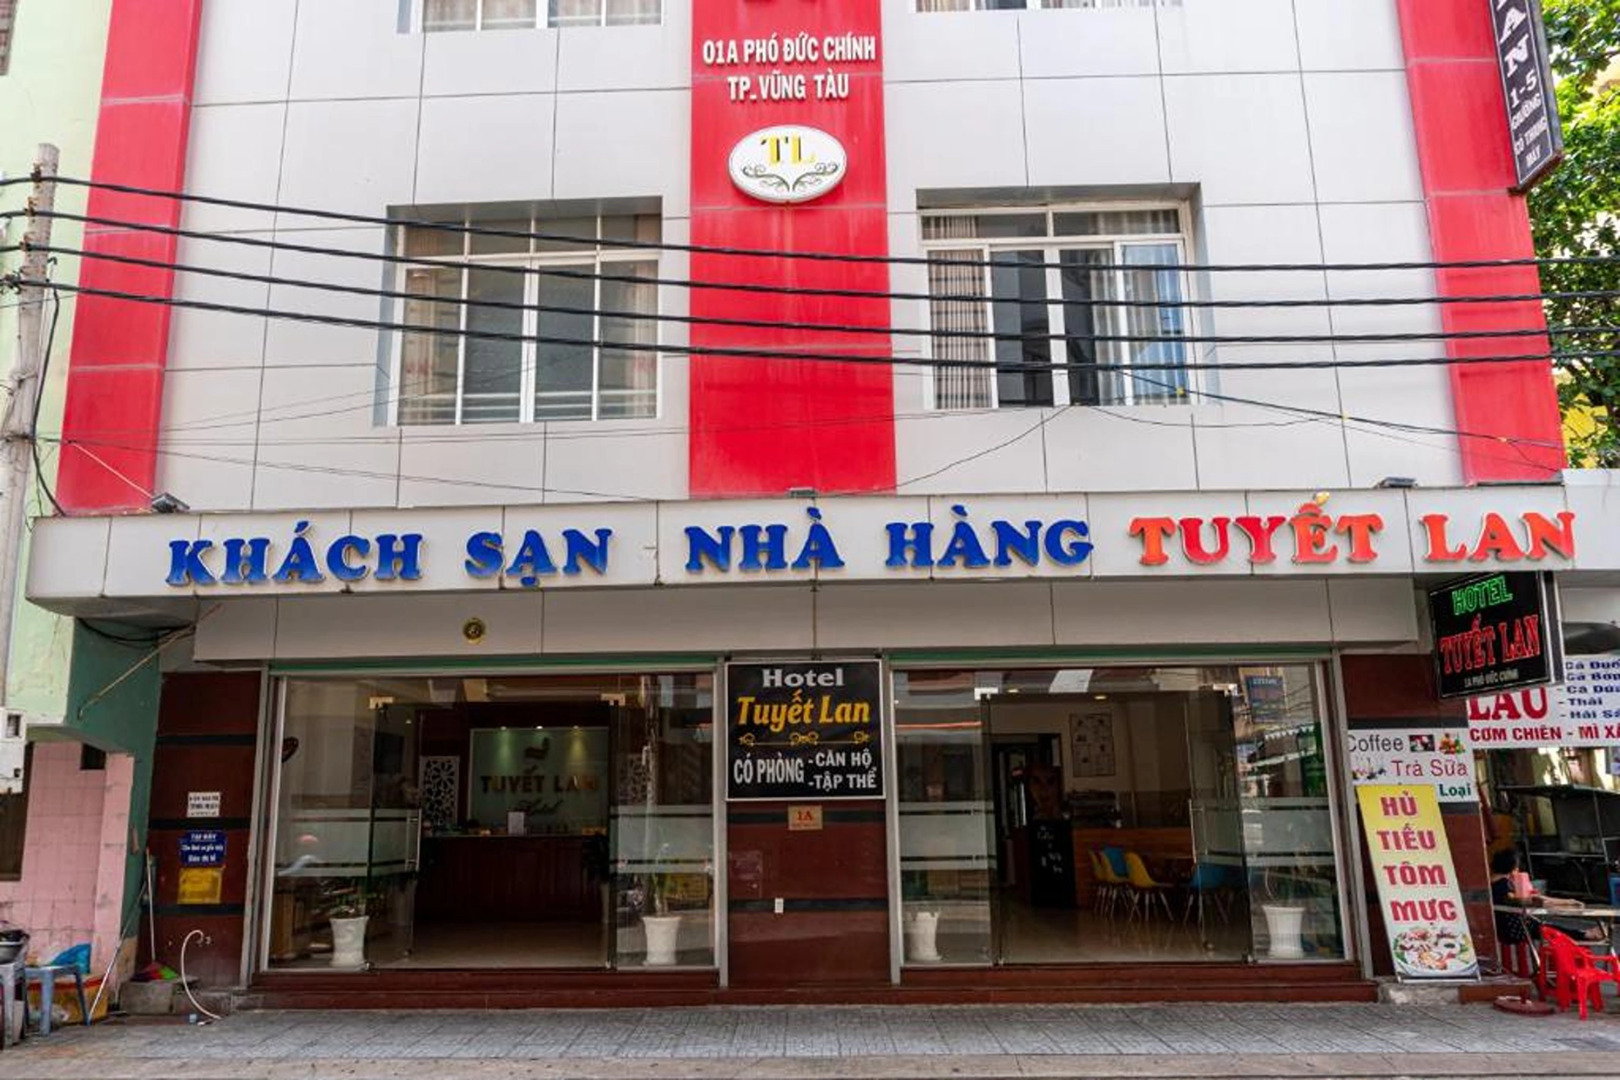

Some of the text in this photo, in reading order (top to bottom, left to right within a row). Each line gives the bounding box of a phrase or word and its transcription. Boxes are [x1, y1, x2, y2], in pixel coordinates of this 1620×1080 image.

[743, 33, 779, 63] PHÓ
[783, 31, 819, 62] ĐỨC
[823, 31, 876, 61] CHÍNH
[814, 68, 849, 99] TÀU
[1509, 69, 1537, 108] 1-5
[760, 132, 818, 166] TL
[165, 491, 1576, 587] KHÁCH SẠN NHÀ HÀNG TUYẾT LAN
[1451, 574, 1513, 616] HOTEL
[1440, 613, 1541, 676] TUYẾT LAN
[762, 668, 845, 688] Hotel
[736, 689, 871, 732] Tuyết Lan
[1469, 727, 1507, 742] CƠM
[1512, 724, 1562, 741] CHIÊN
[1578, 722, 1600, 740] MÌ
[733, 752, 805, 784] CÓ PHÒNG
[851, 747, 873, 769] HỘ
[1431, 758, 1469, 777] Sữa
[481, 764, 545, 794] TUYẾT
[846, 766, 878, 789] THỂ
[1439, 783, 1472, 799] Loại
[1380, 790, 1418, 816] HỦ
[1383, 861, 1447, 886] TÔM
[1390, 900, 1459, 925] MỰC
